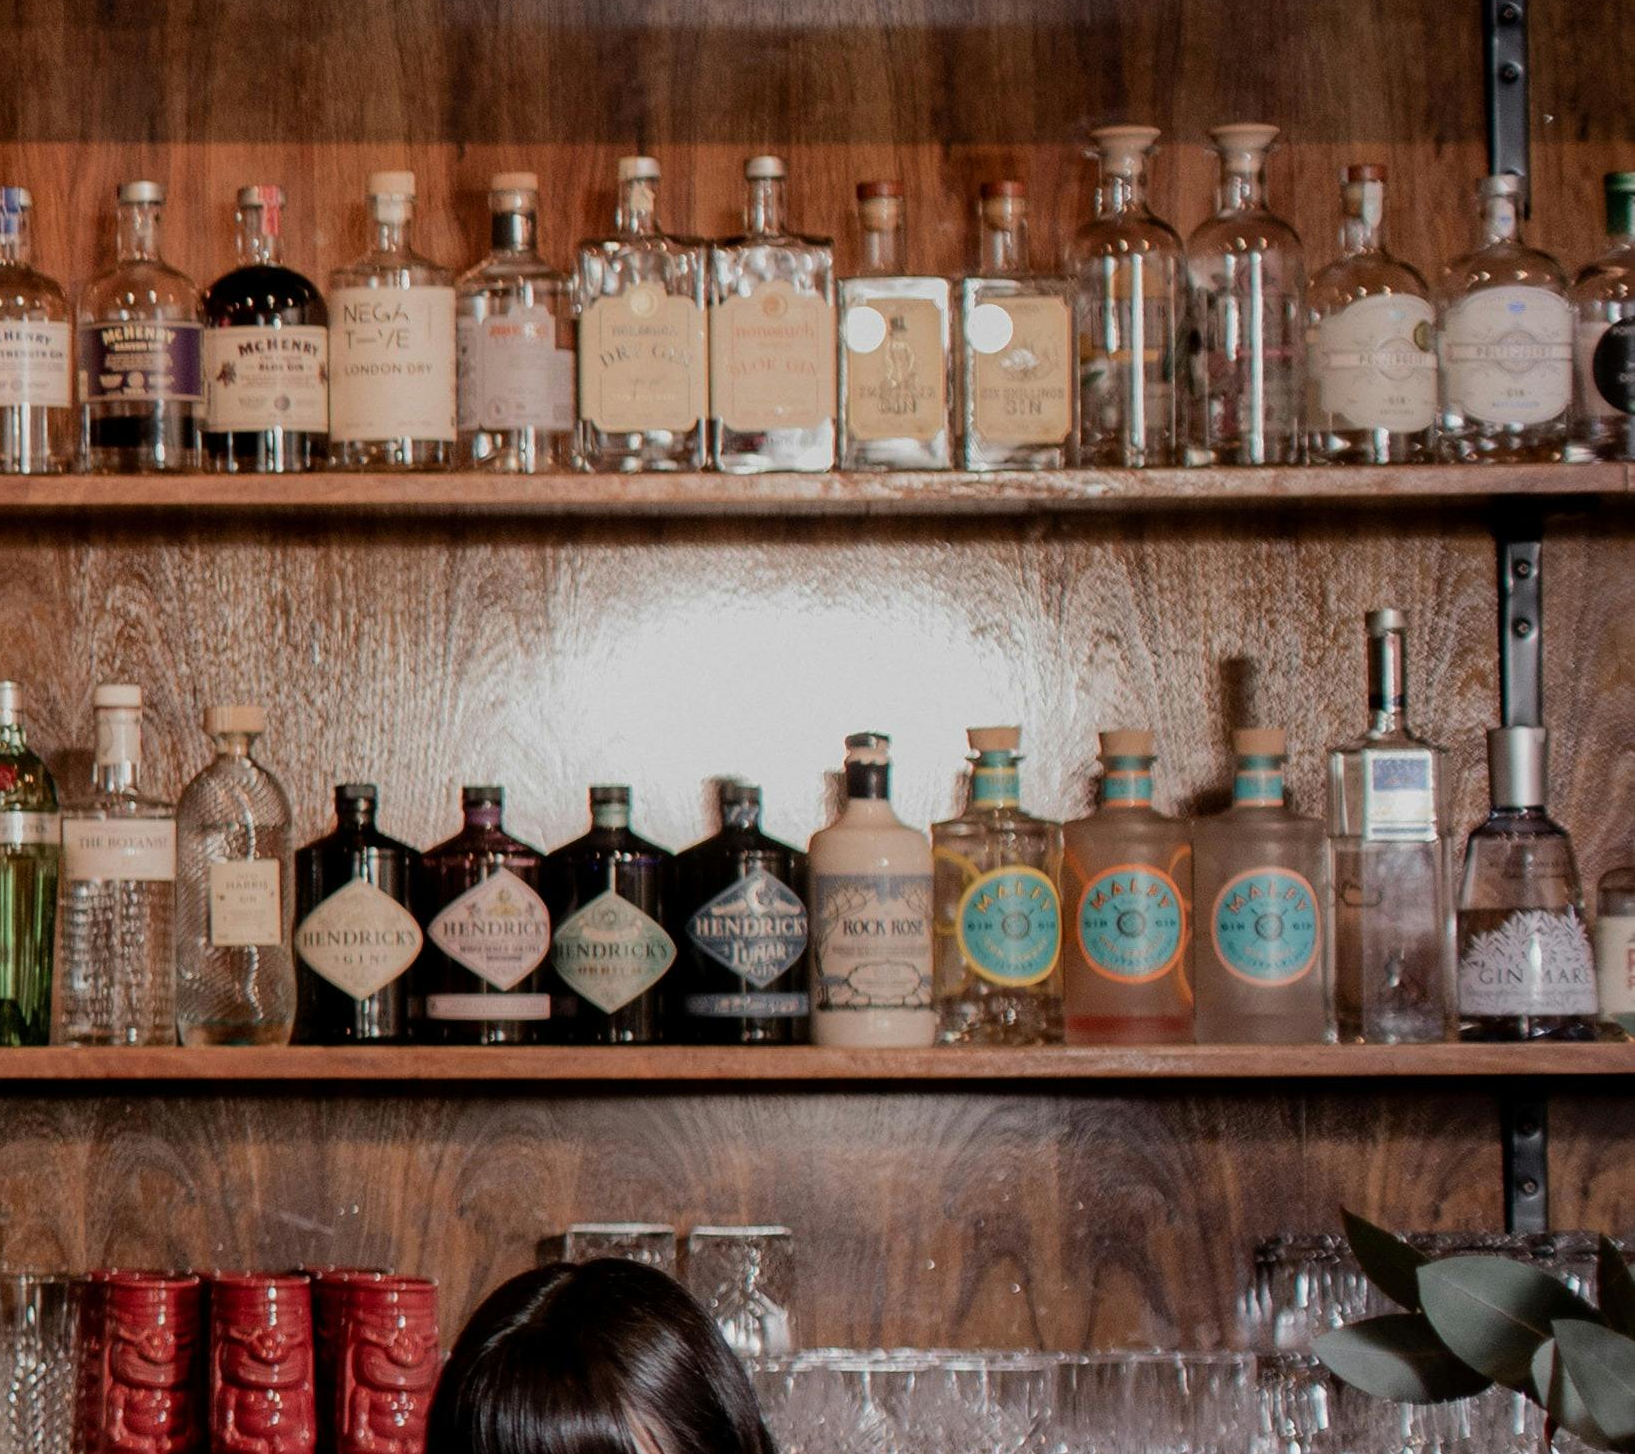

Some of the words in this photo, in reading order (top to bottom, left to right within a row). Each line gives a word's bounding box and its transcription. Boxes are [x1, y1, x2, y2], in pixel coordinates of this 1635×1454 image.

[407, 363, 433, 376] DRY
[1005, 402, 1042, 415] GIN
[79, 837, 104, 848] THE
[108, 836, 166, 848] BOTANIST
[842, 919, 879, 937] ROCK
[884, 919, 923, 937] ROSE
[1479, 970, 1523, 984] GIN
